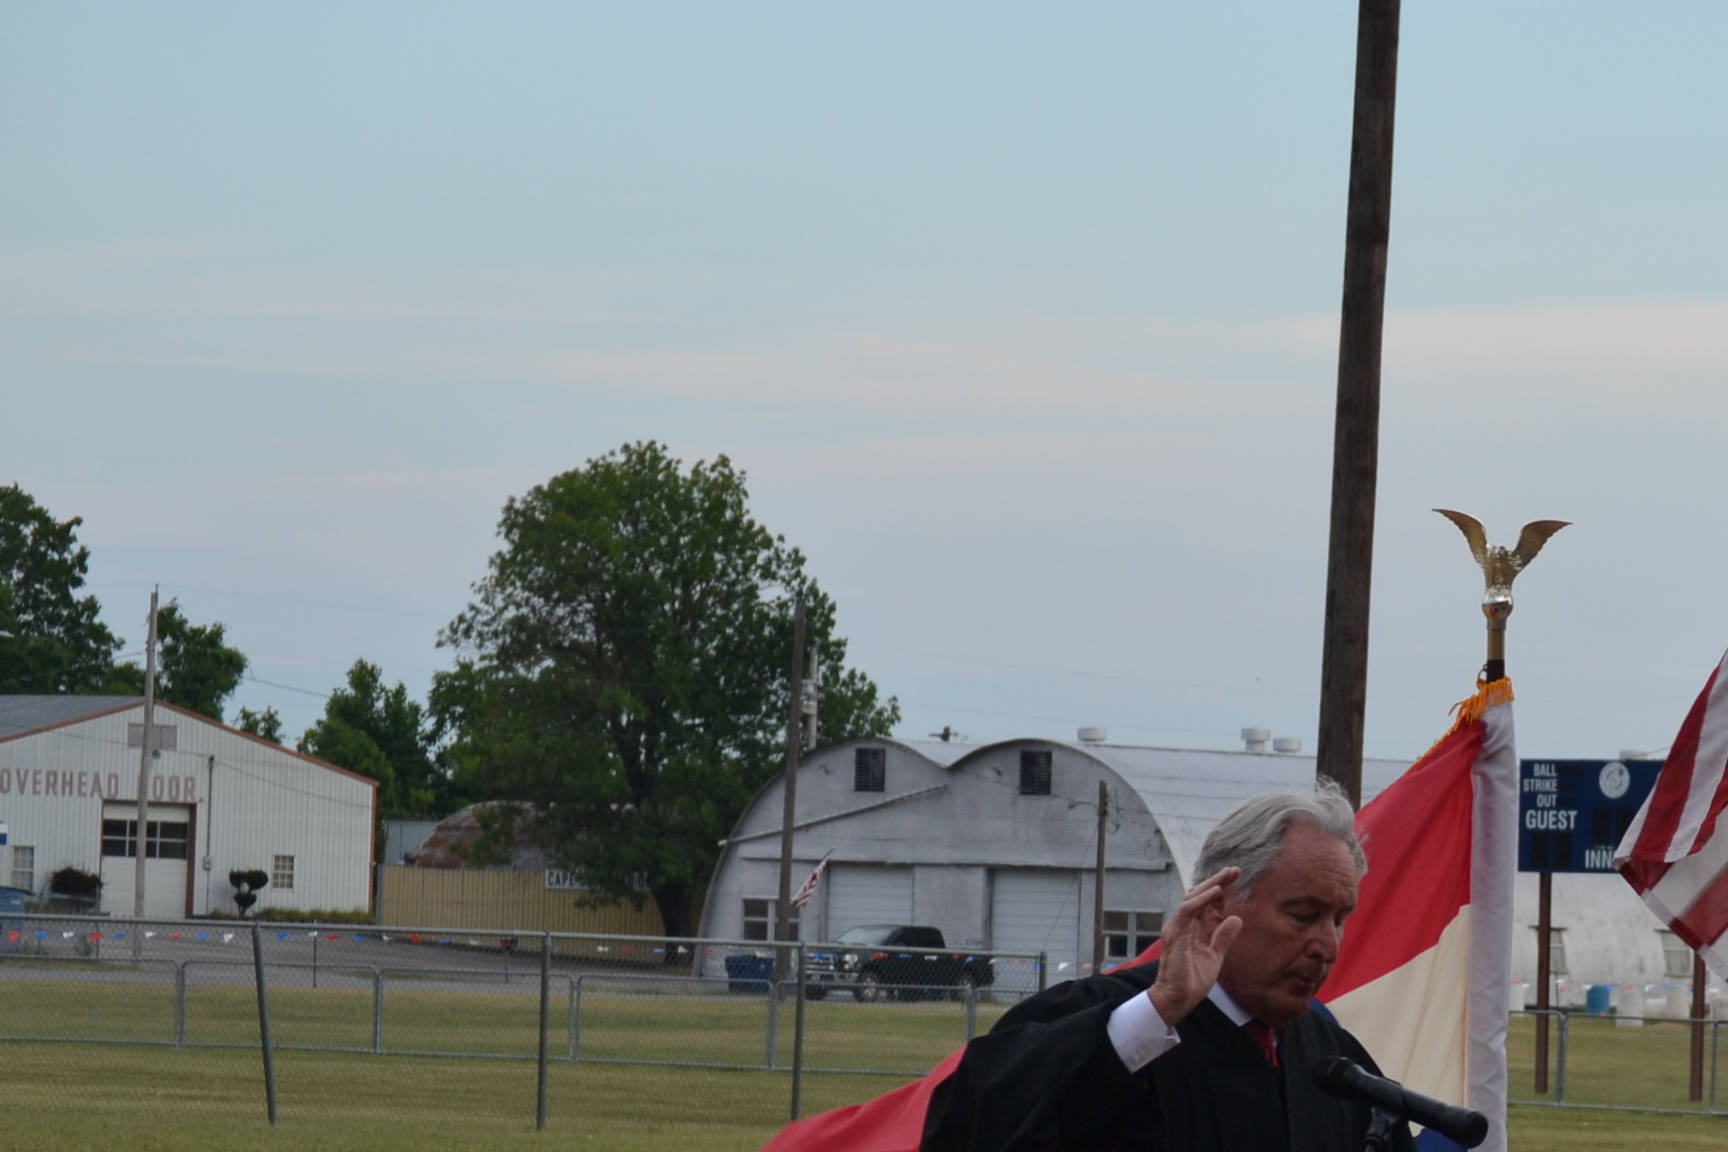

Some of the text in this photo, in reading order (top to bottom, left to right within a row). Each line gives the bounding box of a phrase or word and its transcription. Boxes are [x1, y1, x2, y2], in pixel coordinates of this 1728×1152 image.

[1533, 763, 1557, 777] BALL
[0, 768, 196, 802] OVERHEAD OOR
[1523, 778, 1558, 792] STRIKE
[1536, 793, 1557, 808] OUT
[1525, 809, 1577, 830] GUEST
[1585, 849, 1617, 869] INN
